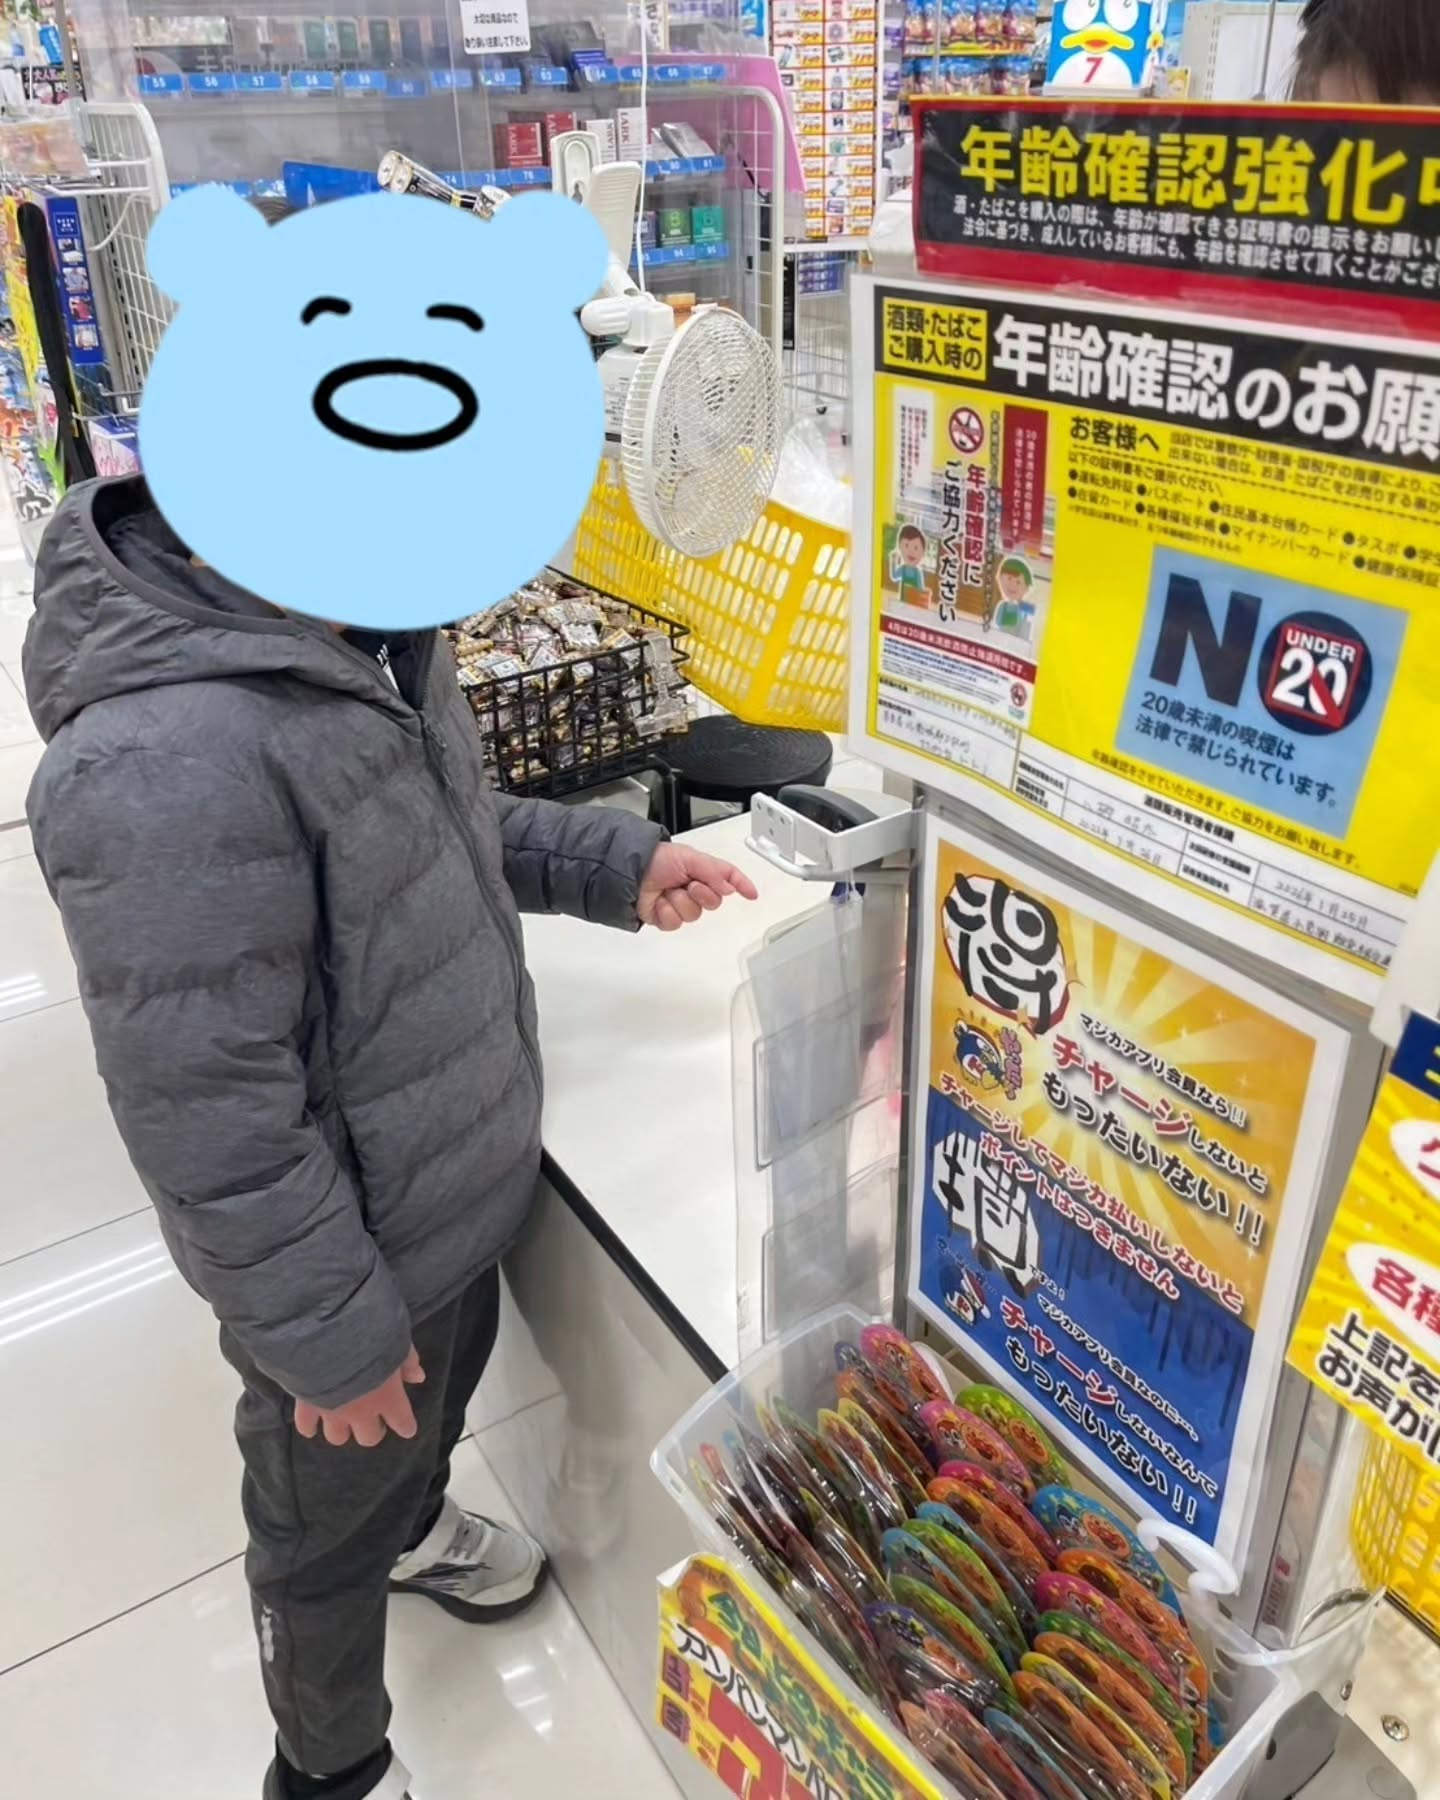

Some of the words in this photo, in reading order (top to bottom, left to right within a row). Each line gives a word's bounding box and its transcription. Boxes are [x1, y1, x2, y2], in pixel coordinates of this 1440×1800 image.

[1083, 57, 1104, 85] 7
[962, 217, 1440, 288] 法令に基づき、成人しているお客様にも、年齢を確認させて頂くことがござ
[887, 303, 983, 342] 酒類・たばこ
[889, 334, 983, 371] ご購入時の
[1070, 415, 1160, 452] お客様へ
[939, 459, 963, 621] ご協力ください
[962, 463, 987, 584] 年齢確認に
[1271, 646, 1349, 717] 20
[1285, 627, 1358, 663] UNDER
[1134, 712, 1337, 808] 法律で禁じられています。
[1140, 690, 1296, 762] 20歳未満の喫煙は
[1052, 1034, 1268, 1194] チャージしないと
[938, 1072, 1244, 1315] チャージしてマジカ払いしないと
[1041, 1070, 1264, 1246] もったいない!!
[979, 1131, 1181, 1301] ポイントはつきません
[1000, 1297, 1220, 1499] チャージしないなんて
